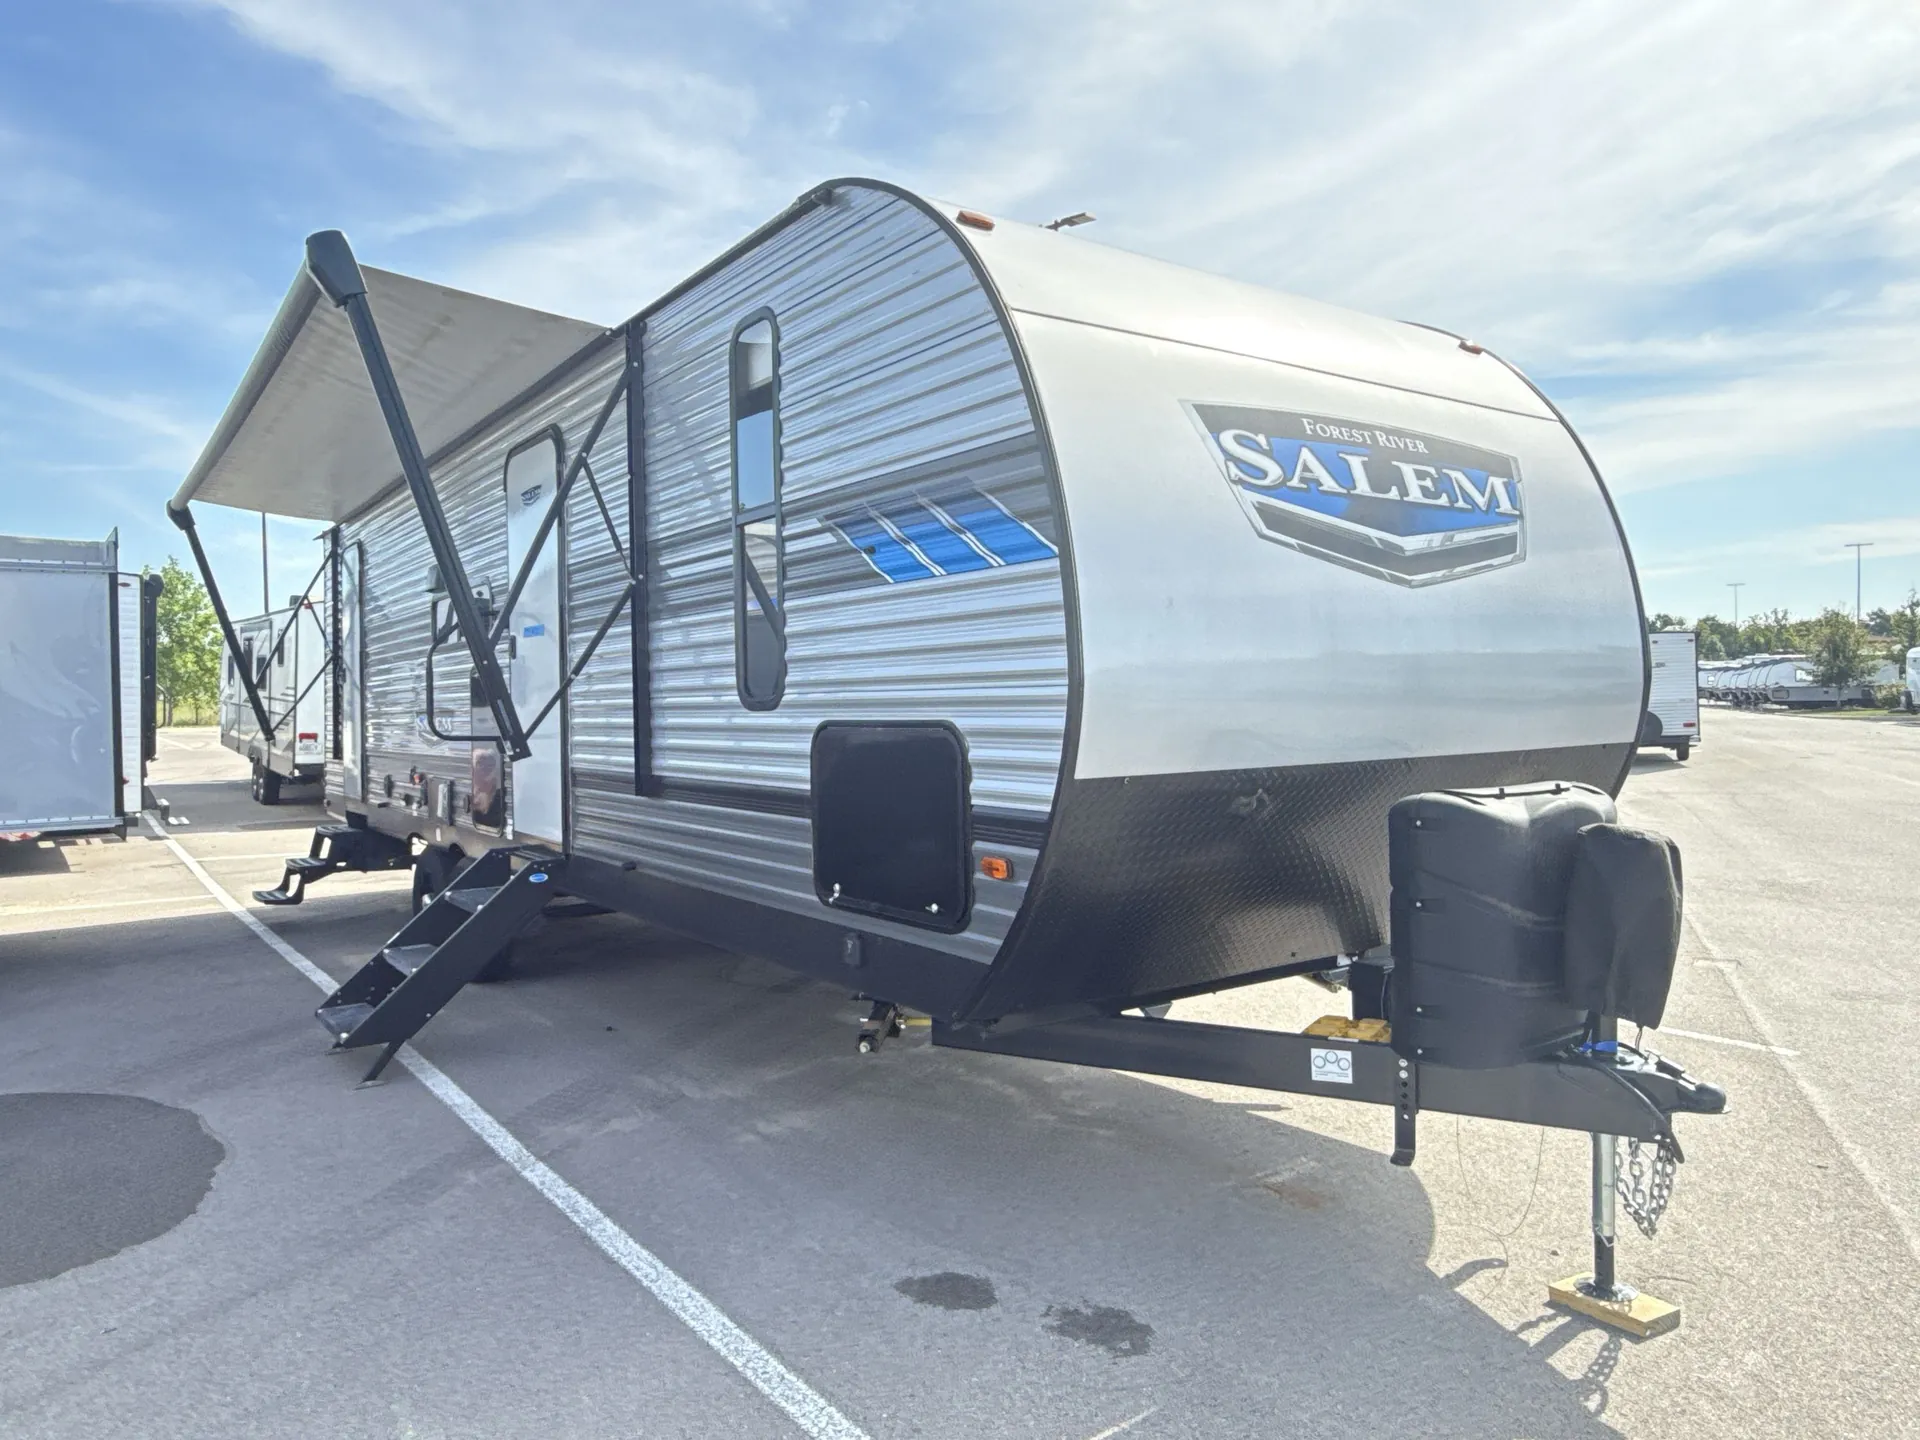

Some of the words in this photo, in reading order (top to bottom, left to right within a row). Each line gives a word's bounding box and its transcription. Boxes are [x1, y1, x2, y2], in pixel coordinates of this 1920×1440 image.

[1301, 417, 1372, 445] FOREST
[1373, 430, 1430, 454] RIVER
[1218, 428, 1520, 516] SALEM
